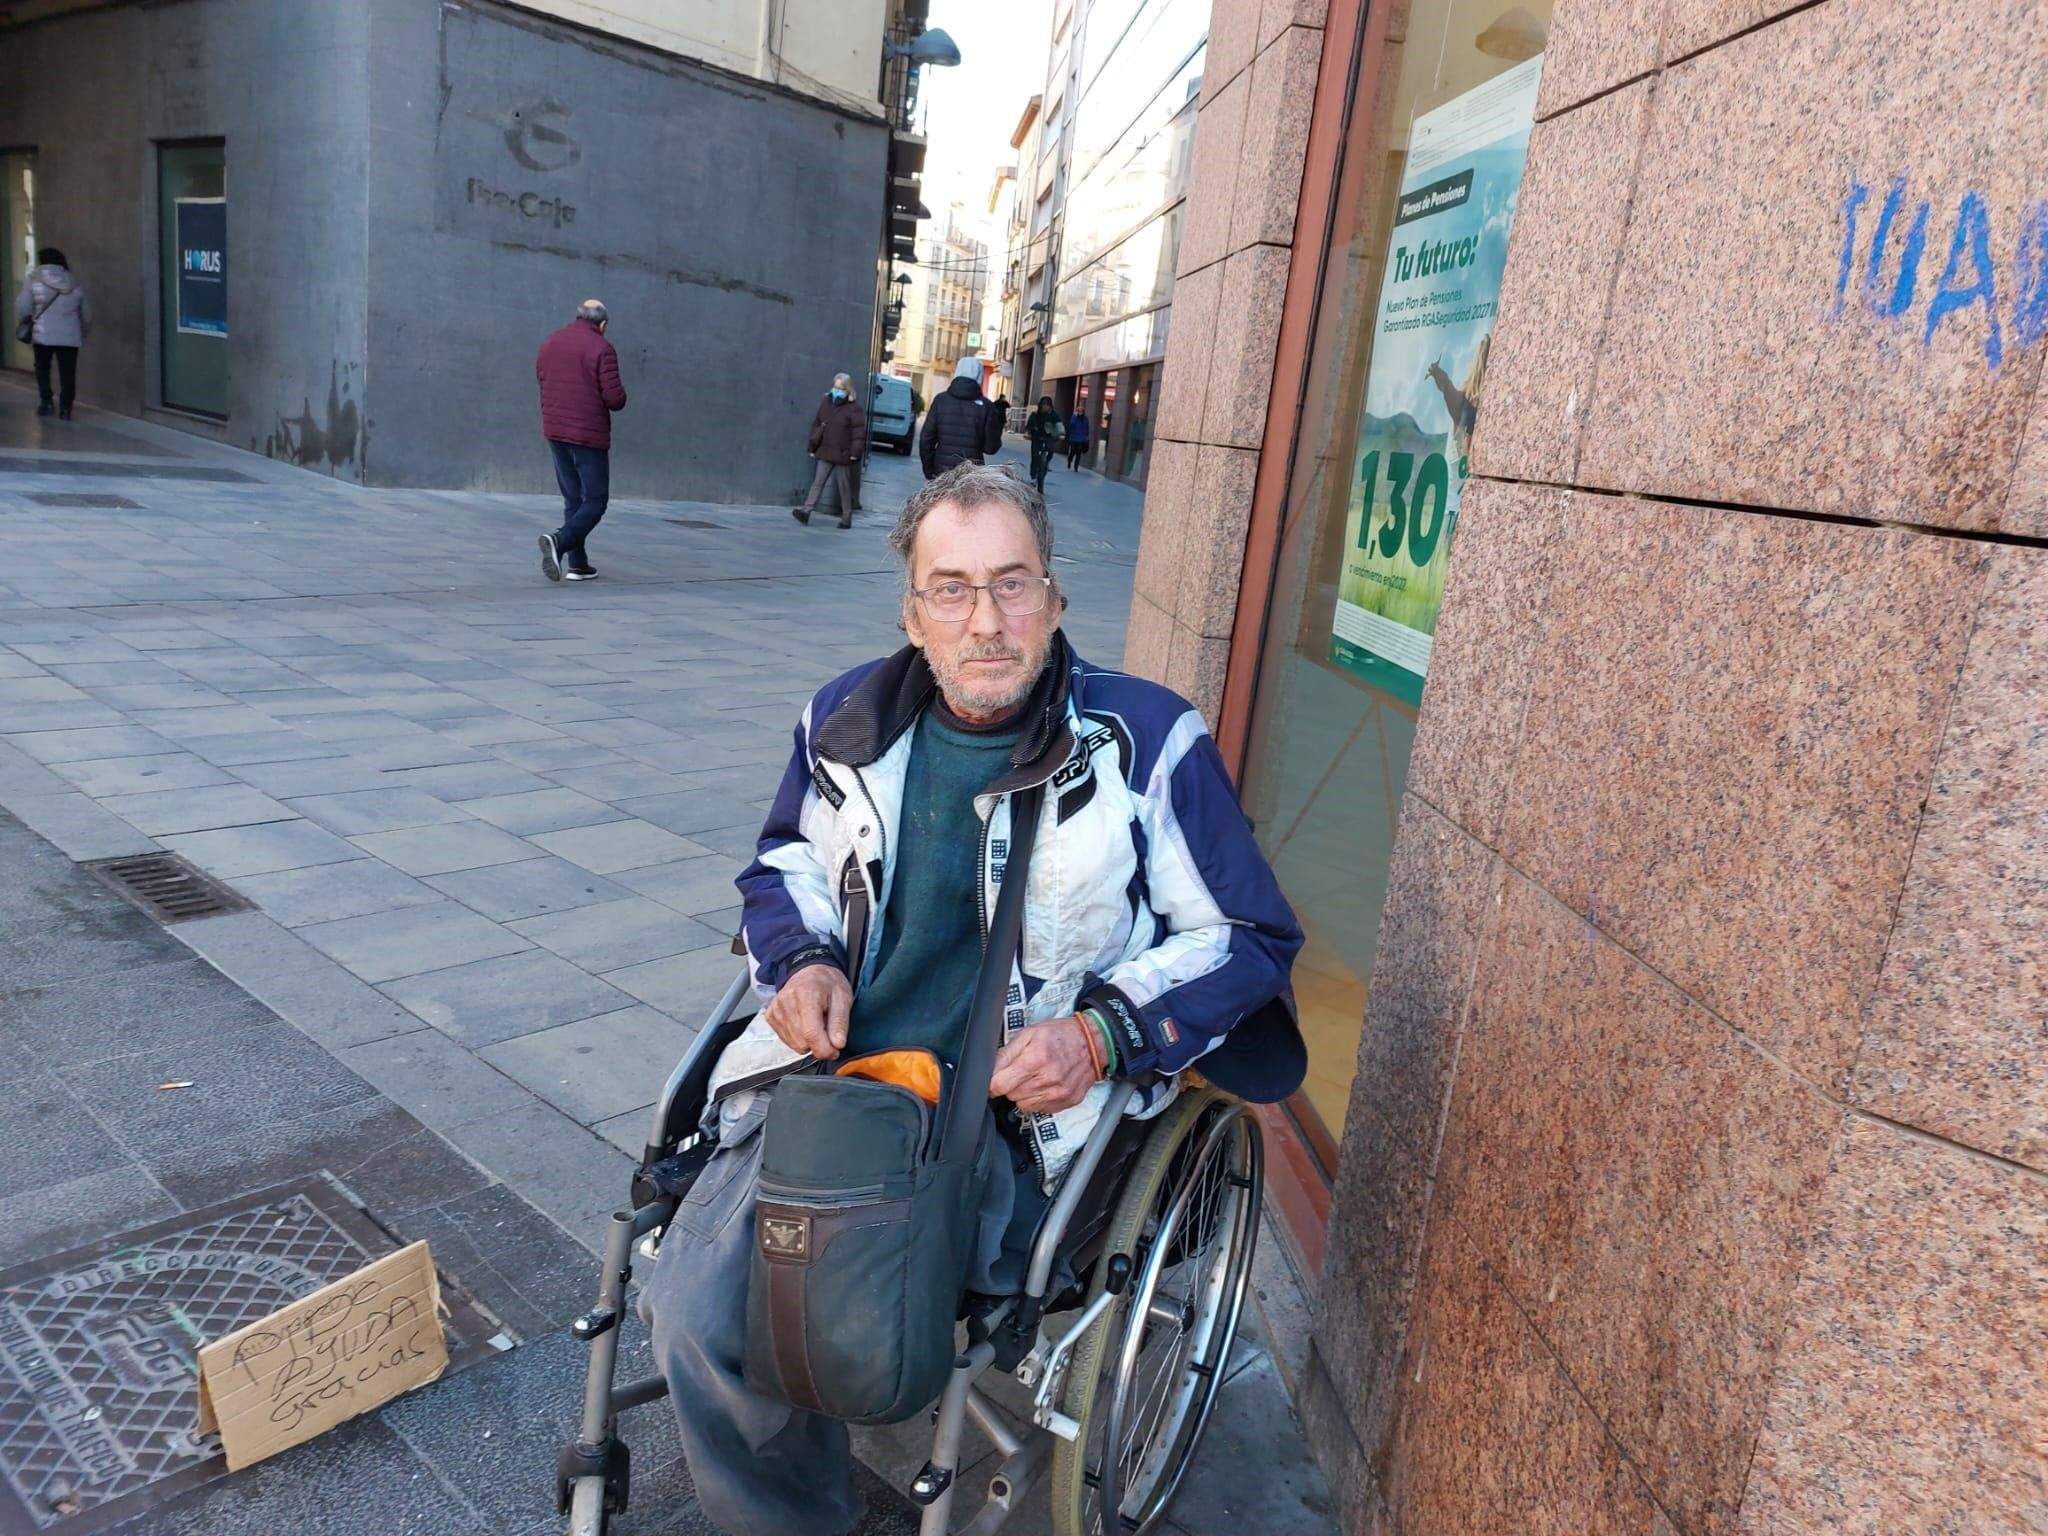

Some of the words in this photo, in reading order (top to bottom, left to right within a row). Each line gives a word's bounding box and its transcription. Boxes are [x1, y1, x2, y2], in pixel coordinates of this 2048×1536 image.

[1400, 201, 1421, 218] Planes
[1421, 195, 1431, 211] de
[1431, 185, 1466, 207] Pensiones
[184, 249, 221, 273] HORUS
[1394, 246, 1414, 283] Tu
[1414, 234, 1479, 279] futuro:
[1386, 300, 1404, 313] Nuevo
[1405, 296, 1419, 310] Plan
[1419, 294, 1428, 307] de
[1428, 290, 1463, 306] Pensiones
[1383, 315, 1421, 333] Garantizado
[254, 1259, 322, 1298] GENE
[272, 1296, 419, 1402] AYUDA
